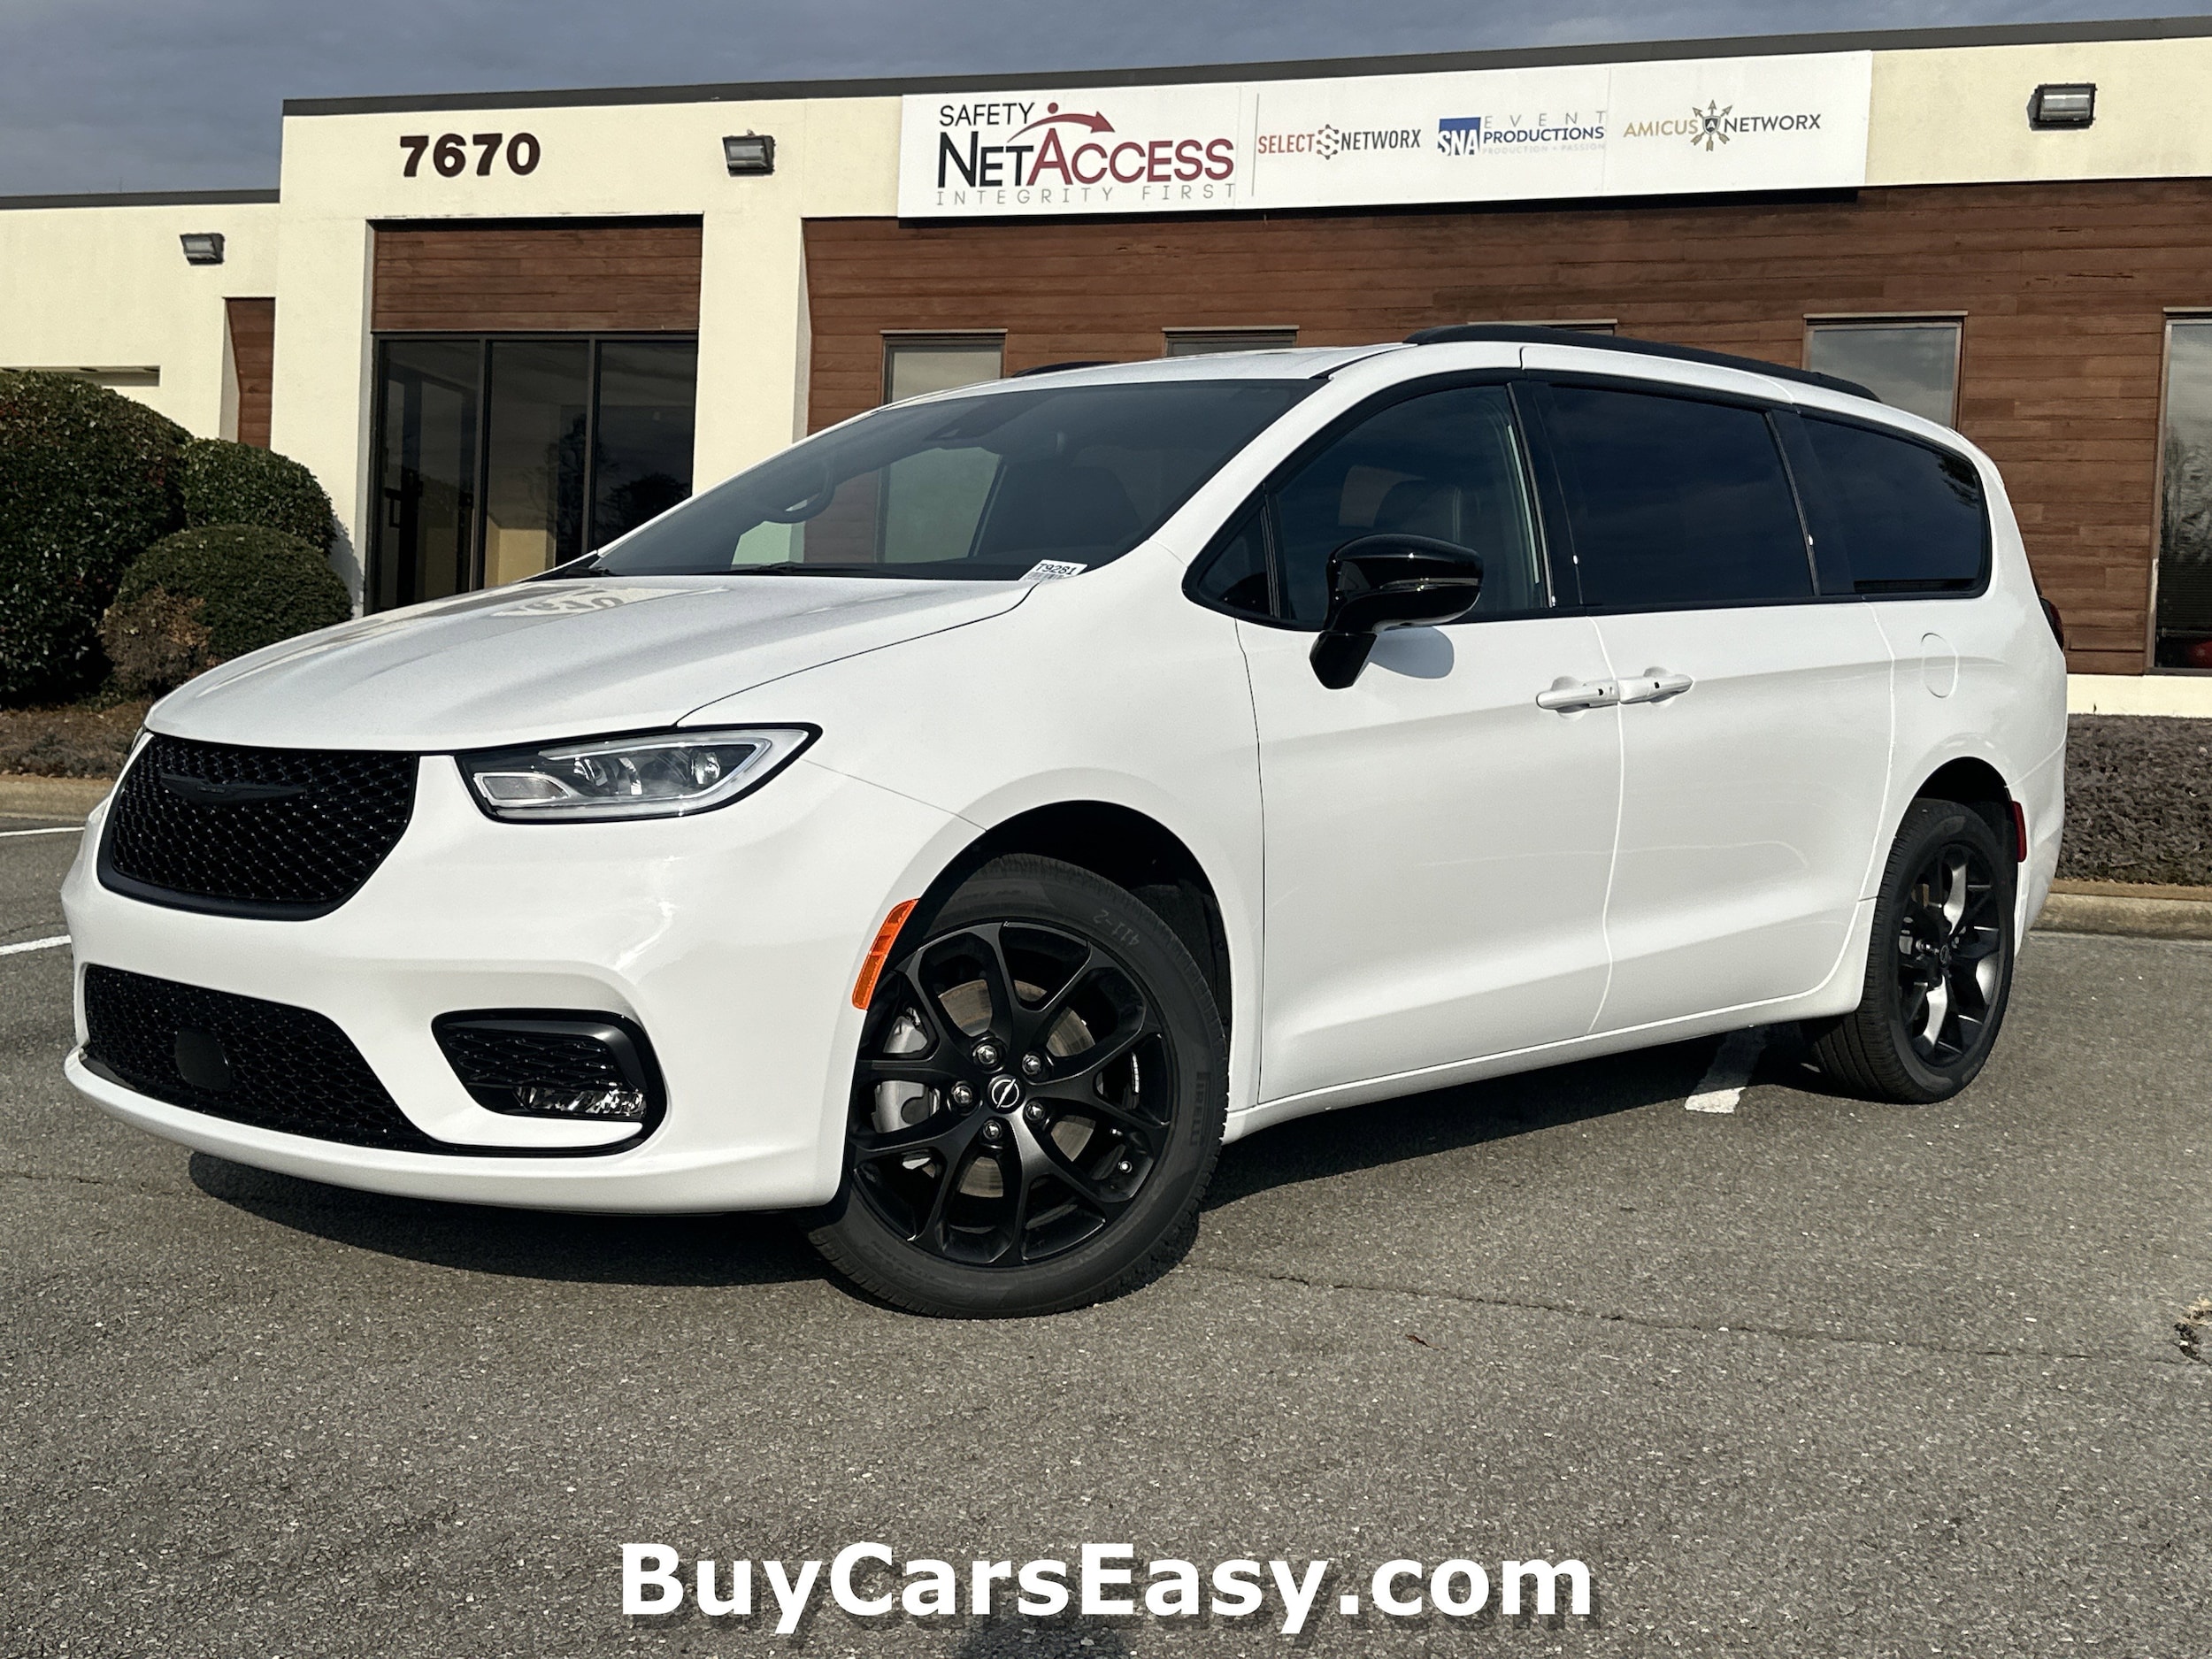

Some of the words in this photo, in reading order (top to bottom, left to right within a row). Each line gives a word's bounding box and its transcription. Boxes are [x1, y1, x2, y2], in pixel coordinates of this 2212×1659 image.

[939, 102, 1035, 127] SAFETY
[1484, 111, 1607, 129] EVENT
[1623, 119, 1699, 138] AMICUS
[1724, 113, 1822, 134] NETWORX
[1257, 134, 1316, 154] SELECT
[1340, 129, 1422, 151] NETWORX
[1437, 128, 1480, 157] SNA
[1483, 126, 1605, 144] PRODUCTIONS
[400, 132, 541, 178] 7670
[936, 186, 1113, 206] INTEGRITY
[1141, 182, 1235, 201] FIRST
